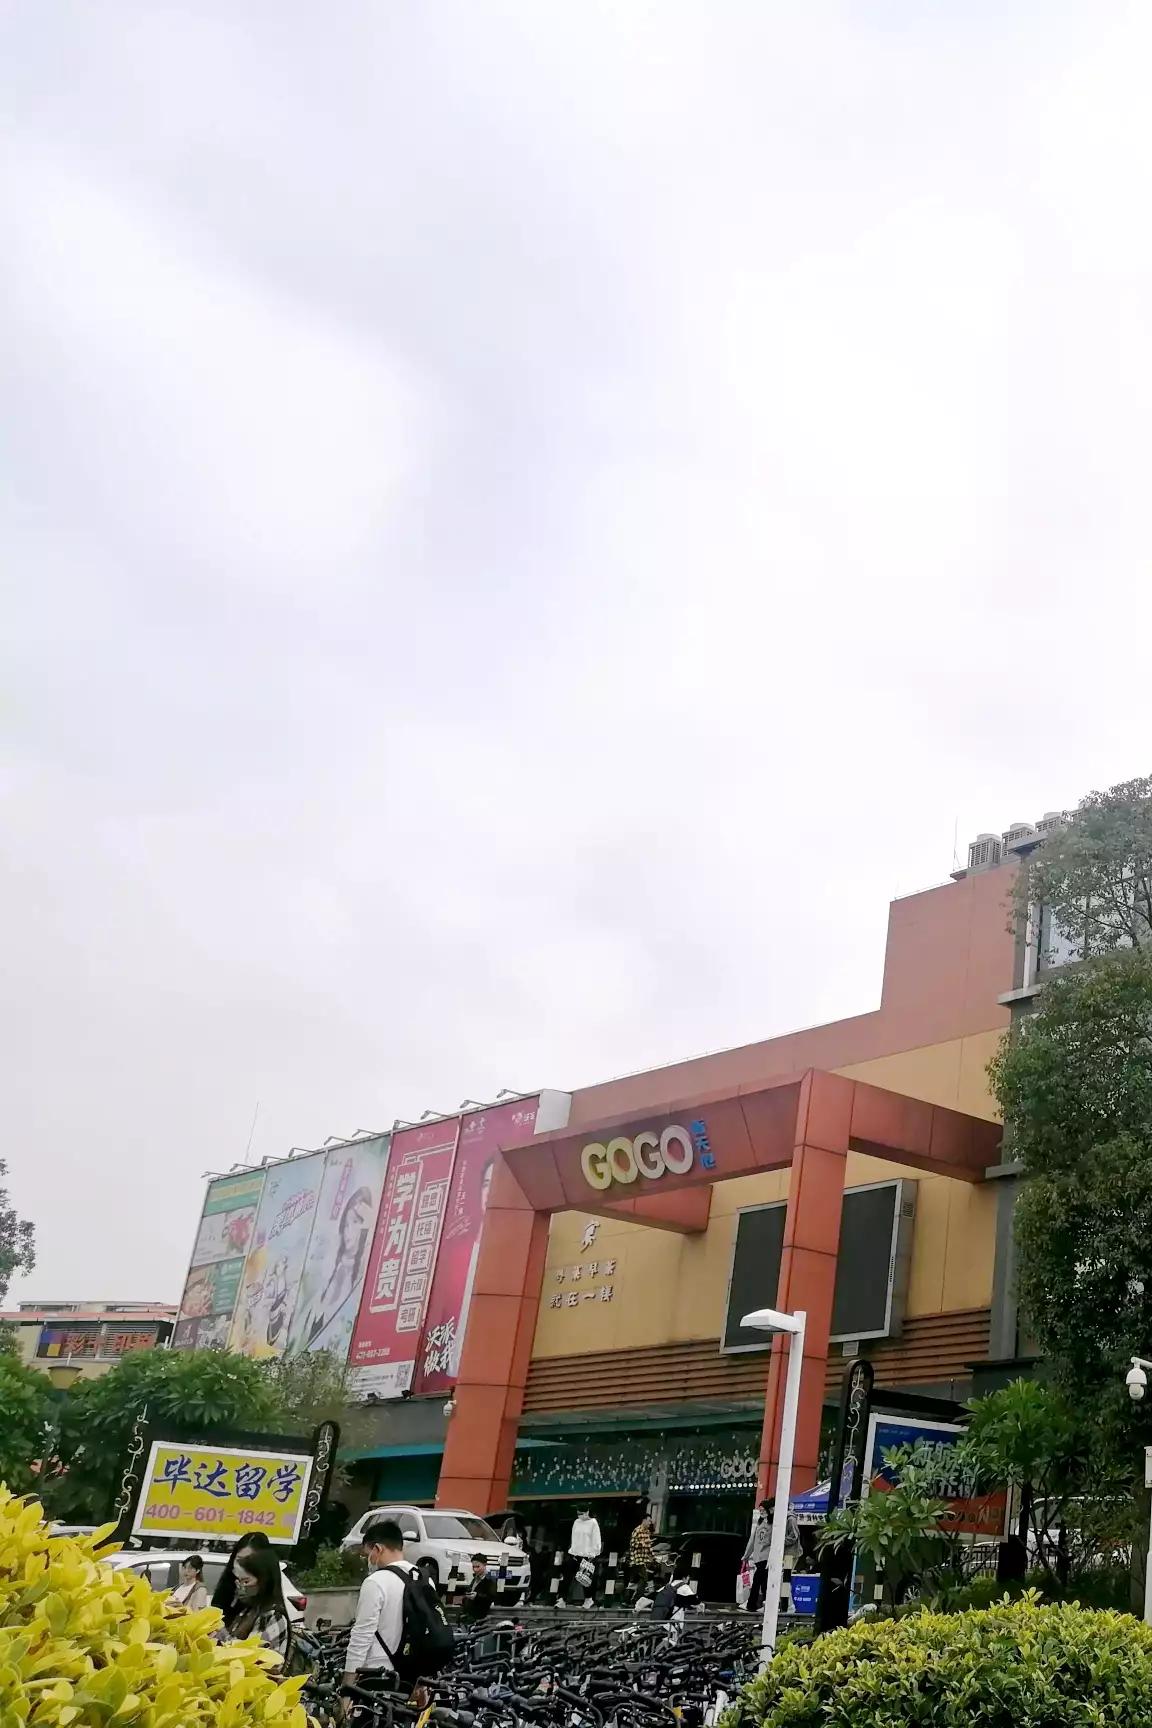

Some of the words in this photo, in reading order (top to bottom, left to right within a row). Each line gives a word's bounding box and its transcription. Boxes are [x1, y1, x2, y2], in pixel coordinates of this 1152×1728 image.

[581, 1124, 694, 1190] GOGO
[154, 1454, 302, 1502] 毕达留学
[145, 1503, 276, 1526] 400-601-1842
